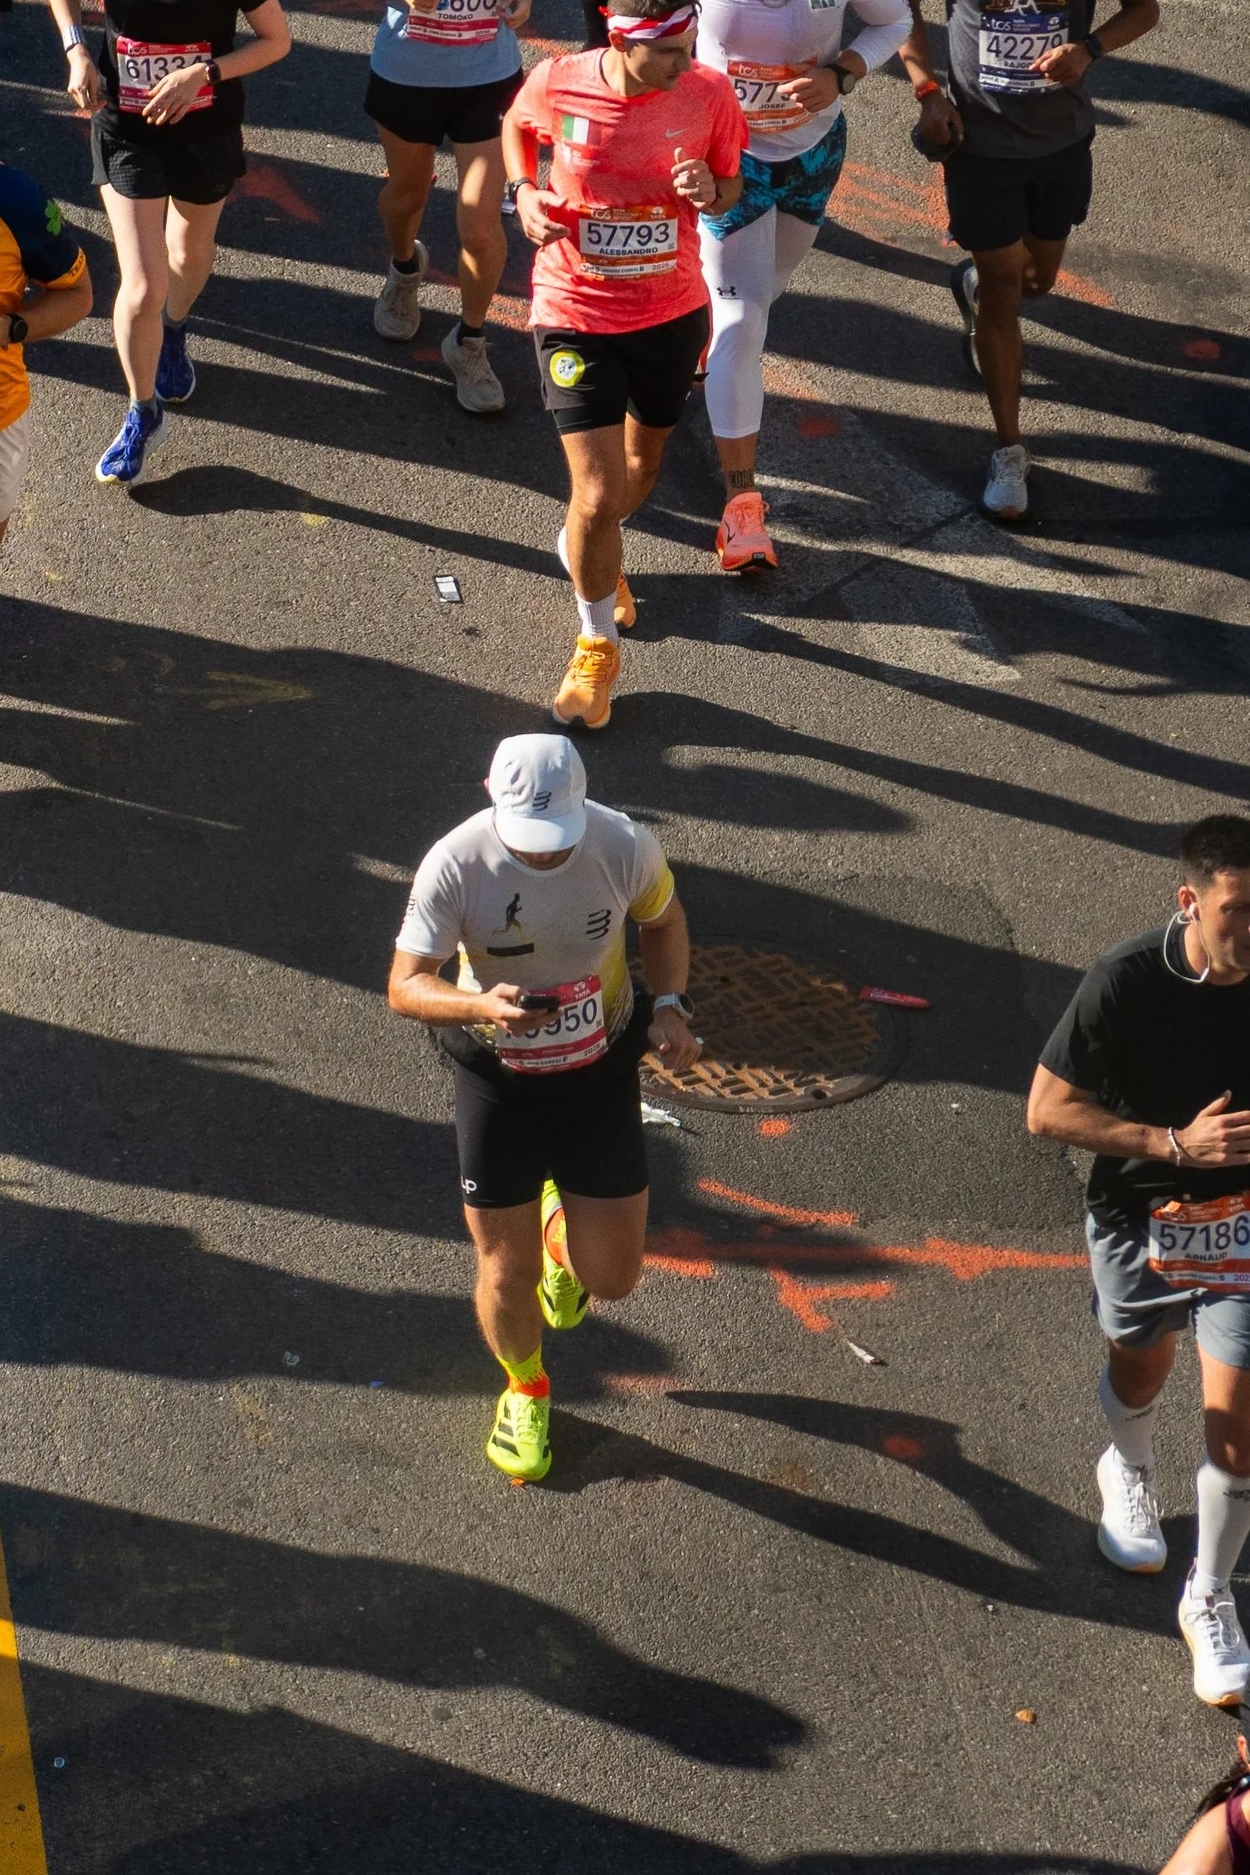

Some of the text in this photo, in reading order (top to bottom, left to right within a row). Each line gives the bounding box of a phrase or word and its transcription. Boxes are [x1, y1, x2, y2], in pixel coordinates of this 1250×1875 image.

[437, 12, 474, 21] TOMOKO
[992, 18, 1011, 31] tcs
[986, 33, 1063, 60] 42279
[738, 63, 758, 77] tcs
[733, 78, 790, 103] 577
[759, 102, 787, 110] JOSEF
[587, 222, 670, 248] 57793
[599, 247, 659, 256] ALESSANDRO
[575, 989, 591, 999] TATA
[1159, 1215, 1250, 1252] 57186
[1184, 1252, 1227, 1261] ARNAUD
